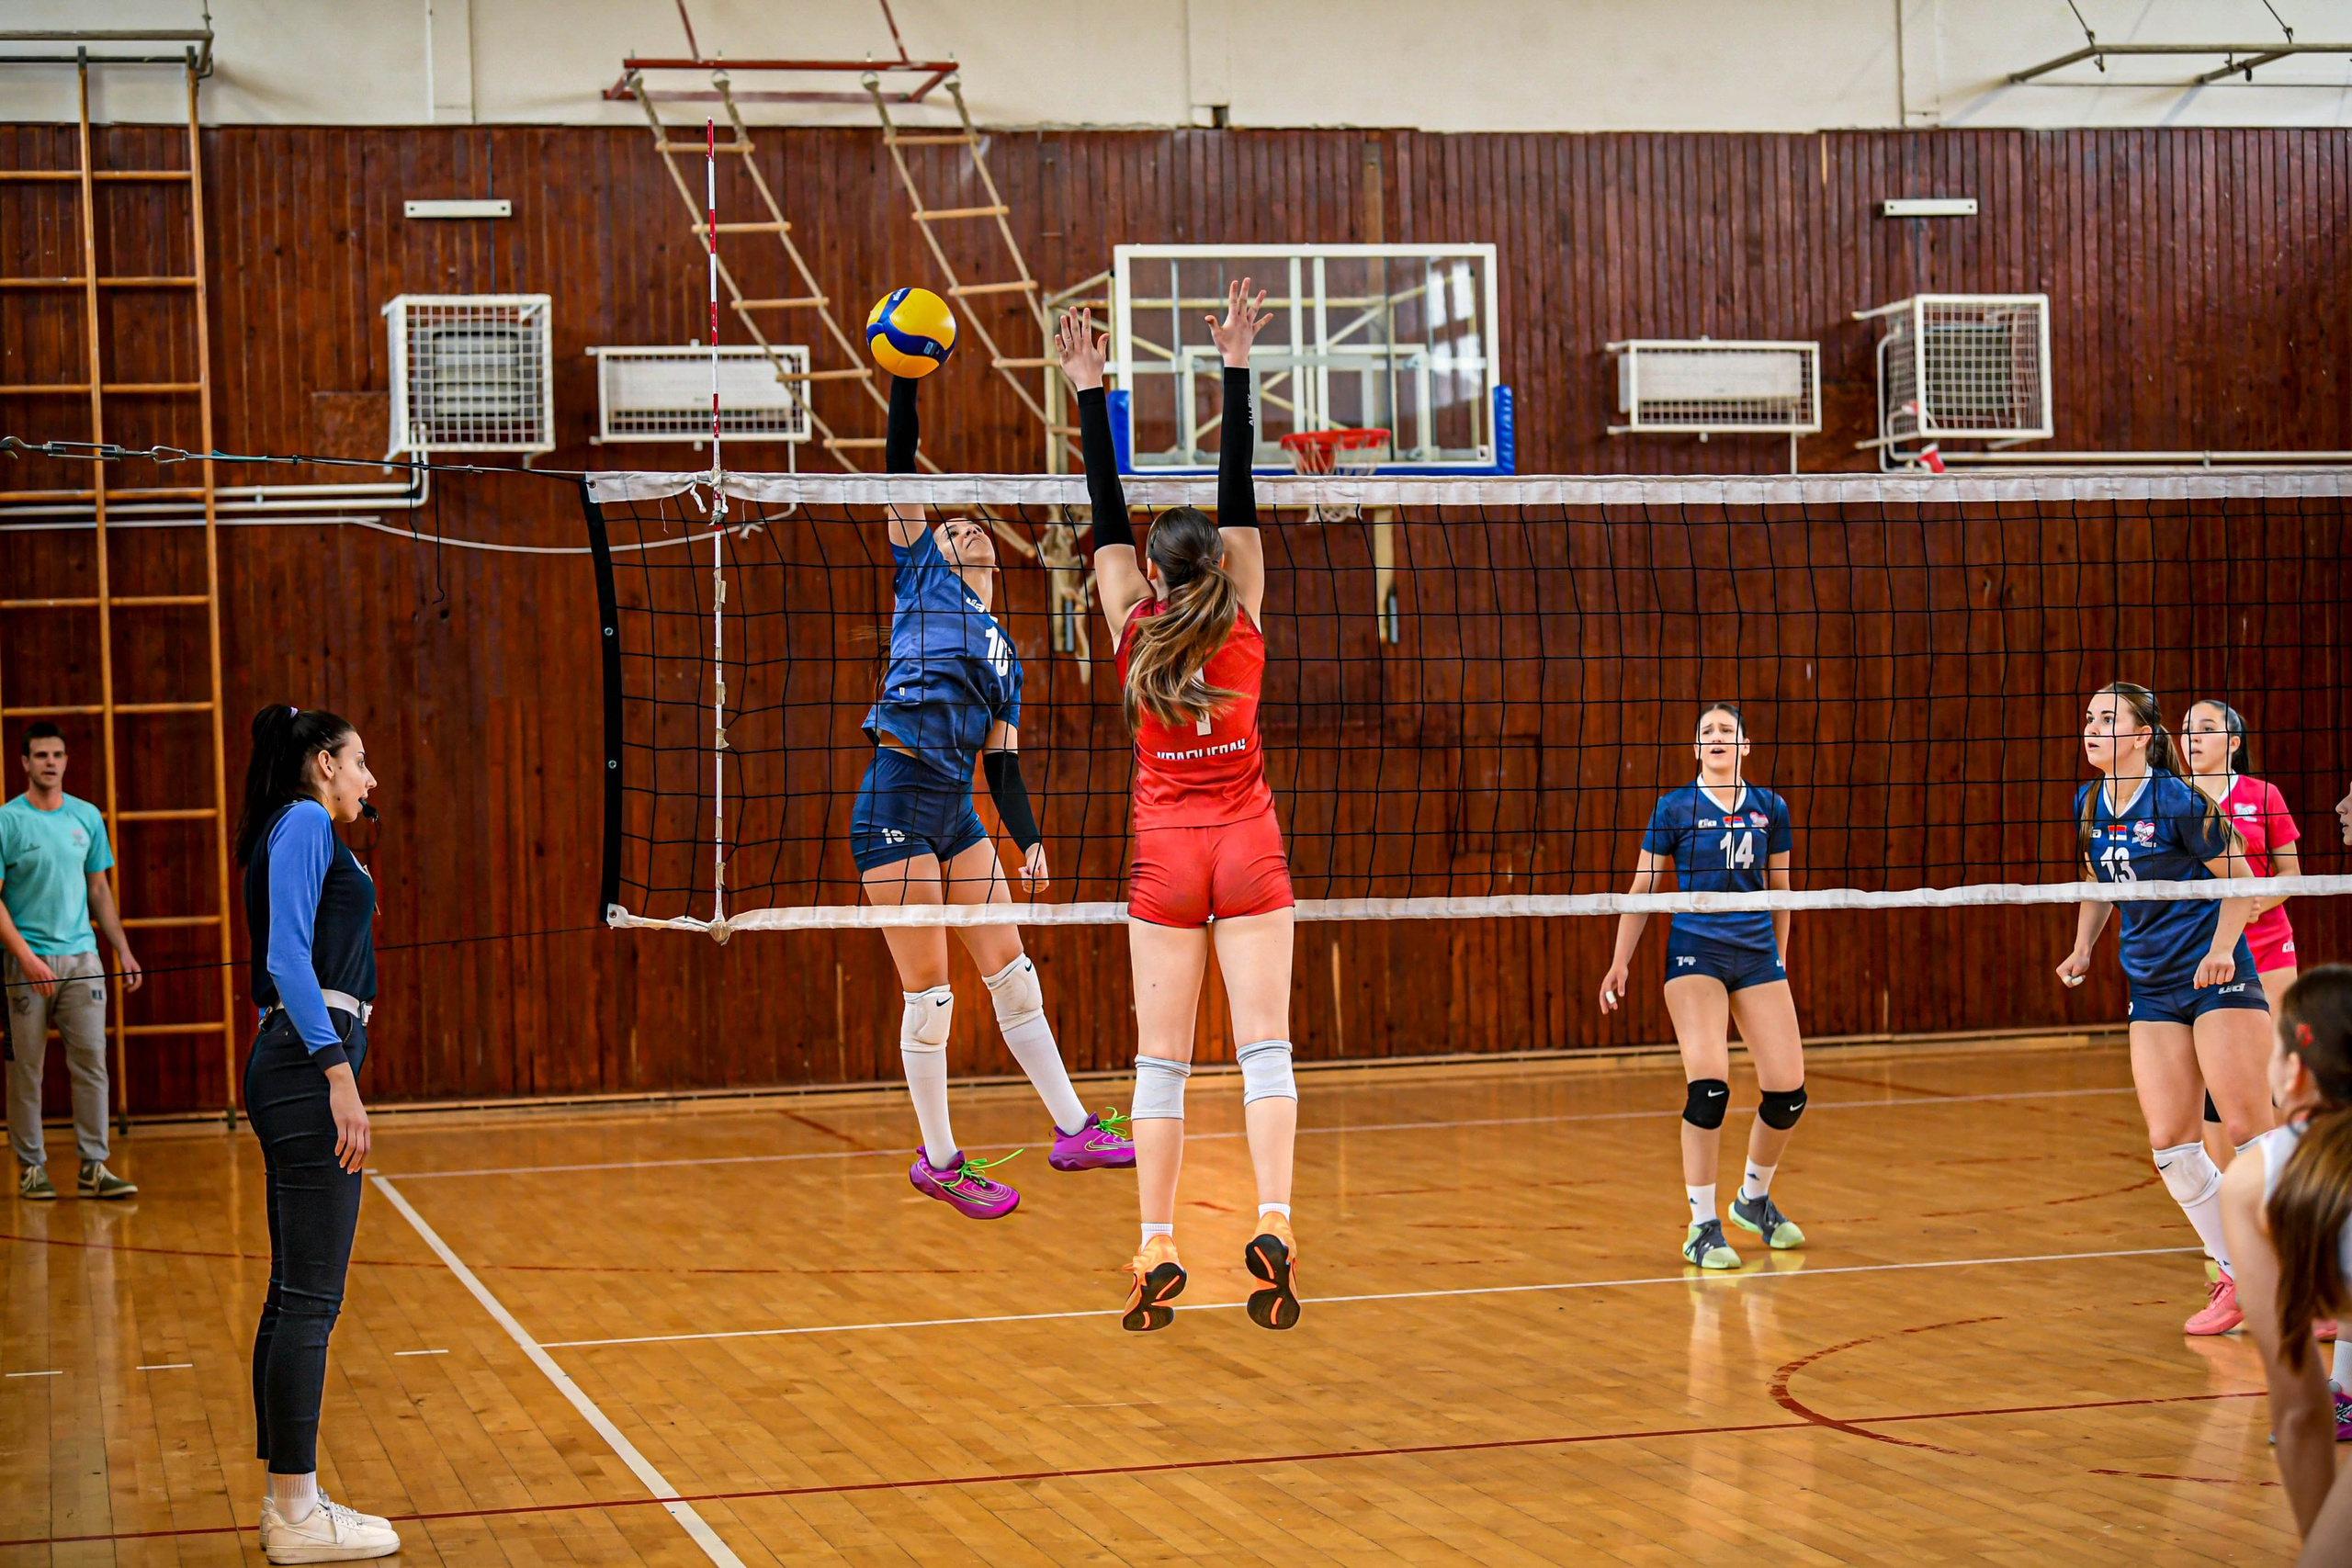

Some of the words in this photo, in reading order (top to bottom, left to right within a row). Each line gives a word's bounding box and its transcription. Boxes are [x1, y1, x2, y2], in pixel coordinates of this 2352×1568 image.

[985, 626, 1010, 677] 10
[882, 828, 905, 844] 10
[1720, 830, 1754, 869] 14
[2100, 846, 2137, 882] 13
